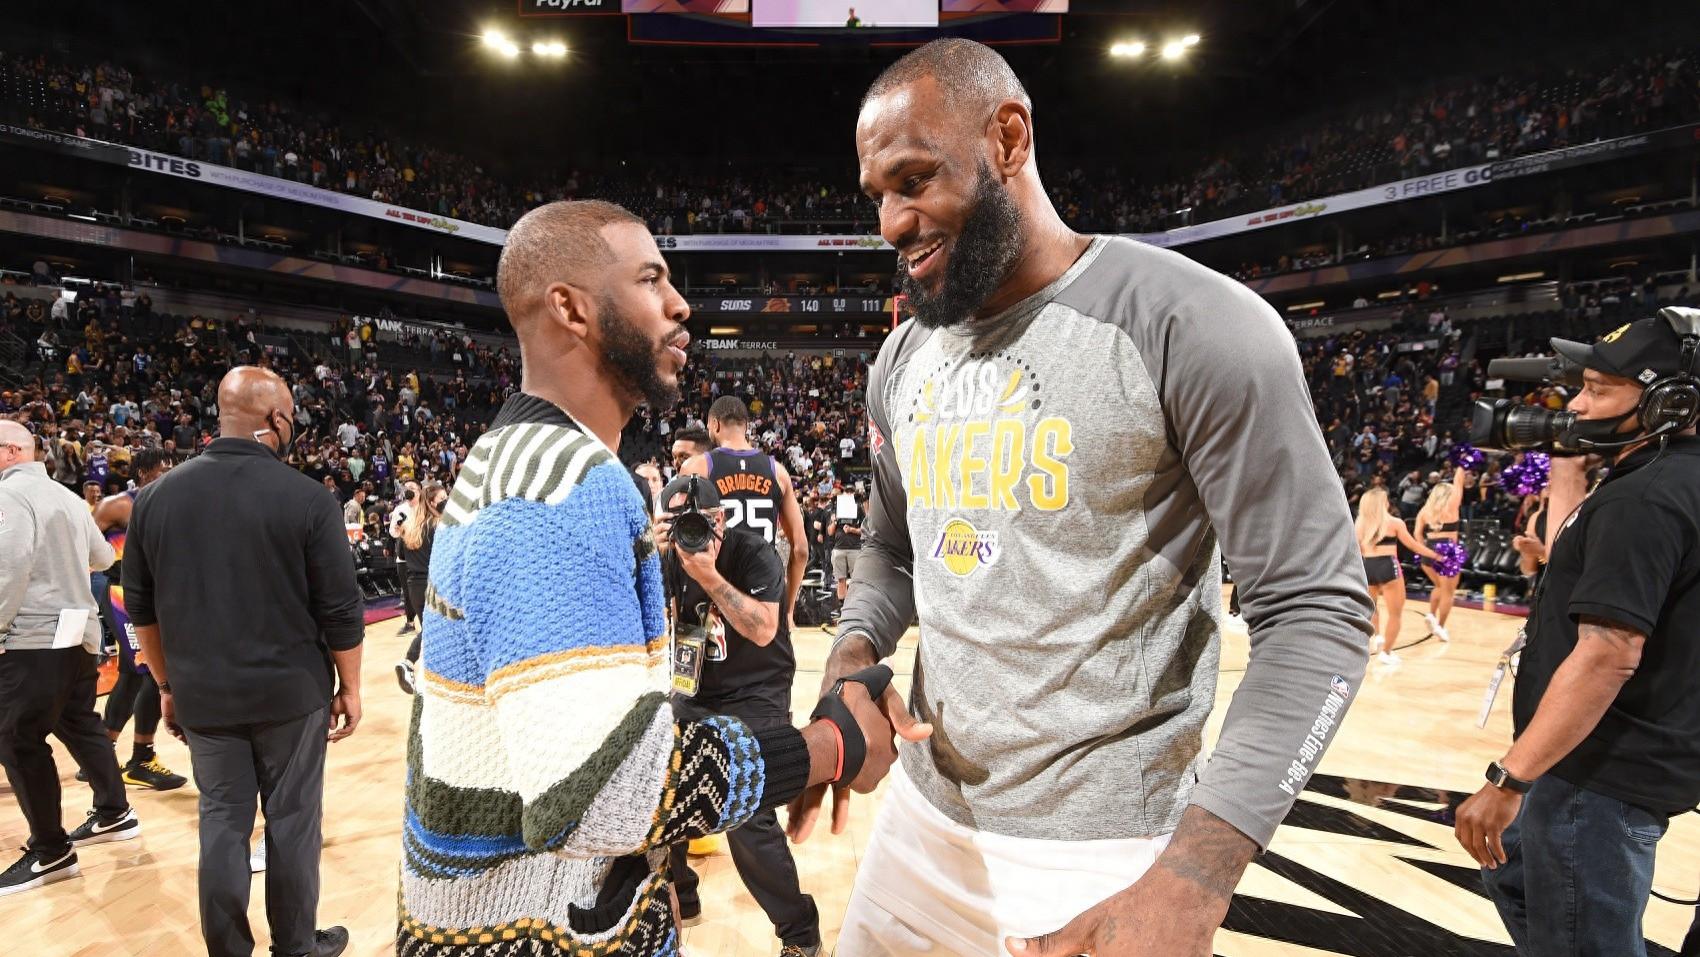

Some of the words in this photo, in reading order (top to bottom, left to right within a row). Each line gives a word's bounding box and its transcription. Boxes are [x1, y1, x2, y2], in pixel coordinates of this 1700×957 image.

[127, 150, 201, 178] BITES
[1385, 186, 1397, 200] 3
[1403, 173, 1458, 196] FREE
[720, 299, 752, 311] SUNS
[800, 299, 820, 312] 140
[862, 299, 880, 312] 111
[739, 341, 777, 350] TERRACE
[895, 417, 1075, 511] AKERS
[716, 472, 773, 496] BRIDGES
[720, 498, 774, 544] 25
[934, 532, 993, 564] LAKERS
[123, 622, 141, 650] SUNS
